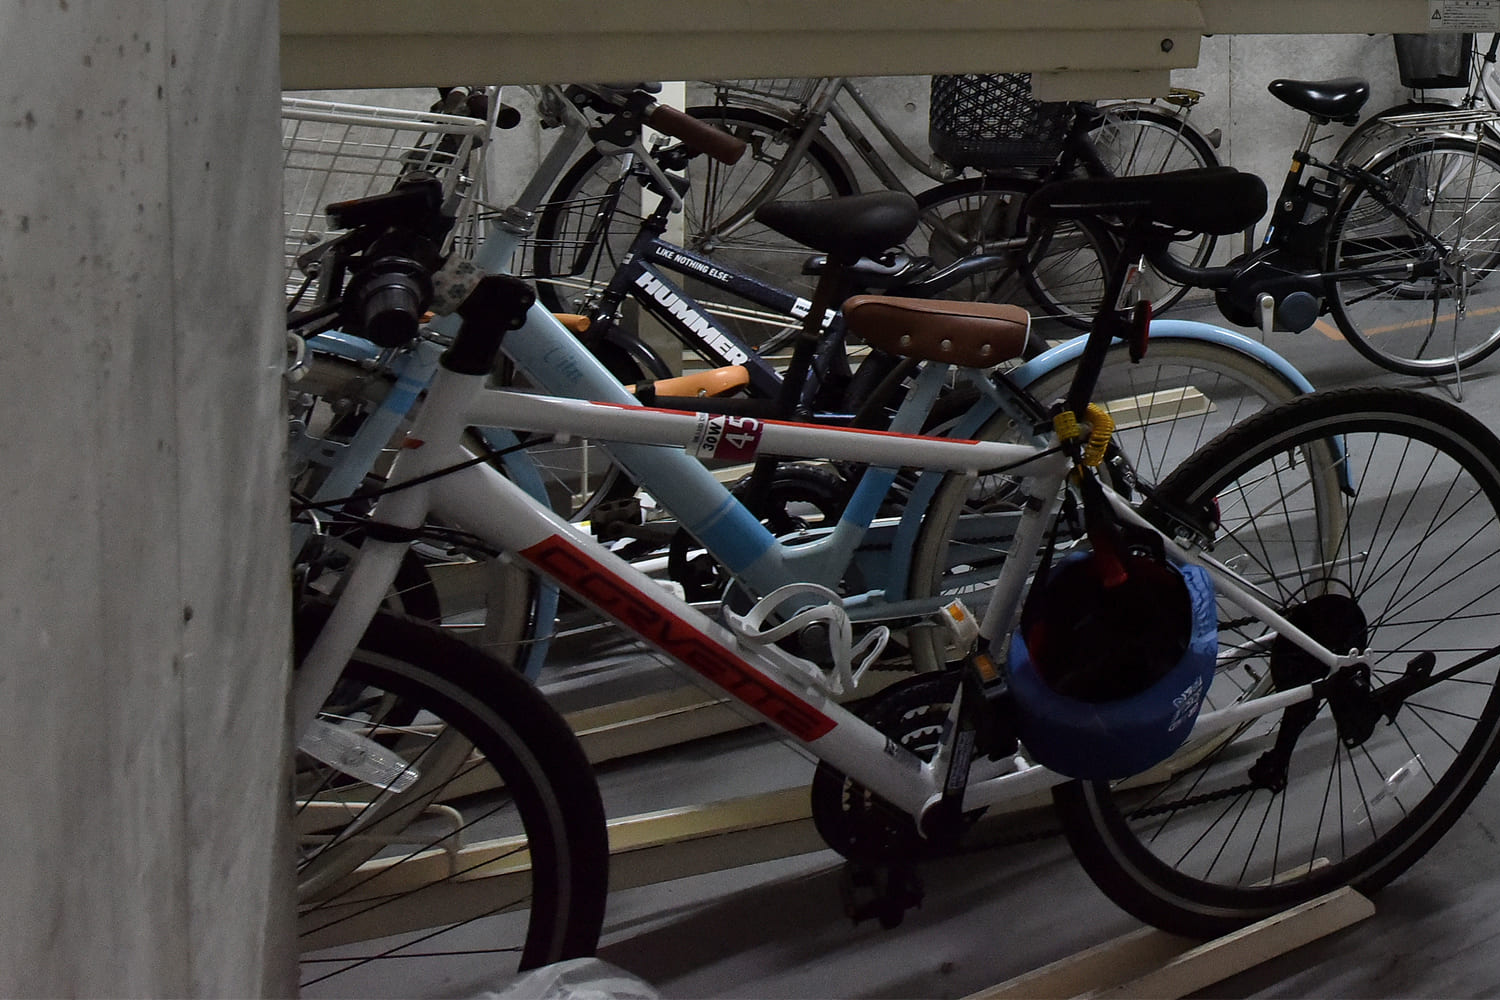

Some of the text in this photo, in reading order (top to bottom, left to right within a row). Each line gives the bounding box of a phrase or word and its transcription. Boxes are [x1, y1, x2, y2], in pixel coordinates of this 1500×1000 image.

[655, 246, 676, 260] LIKE
[674, 254, 709, 274] NOTHING
[635, 271, 749, 367] HUMMER
